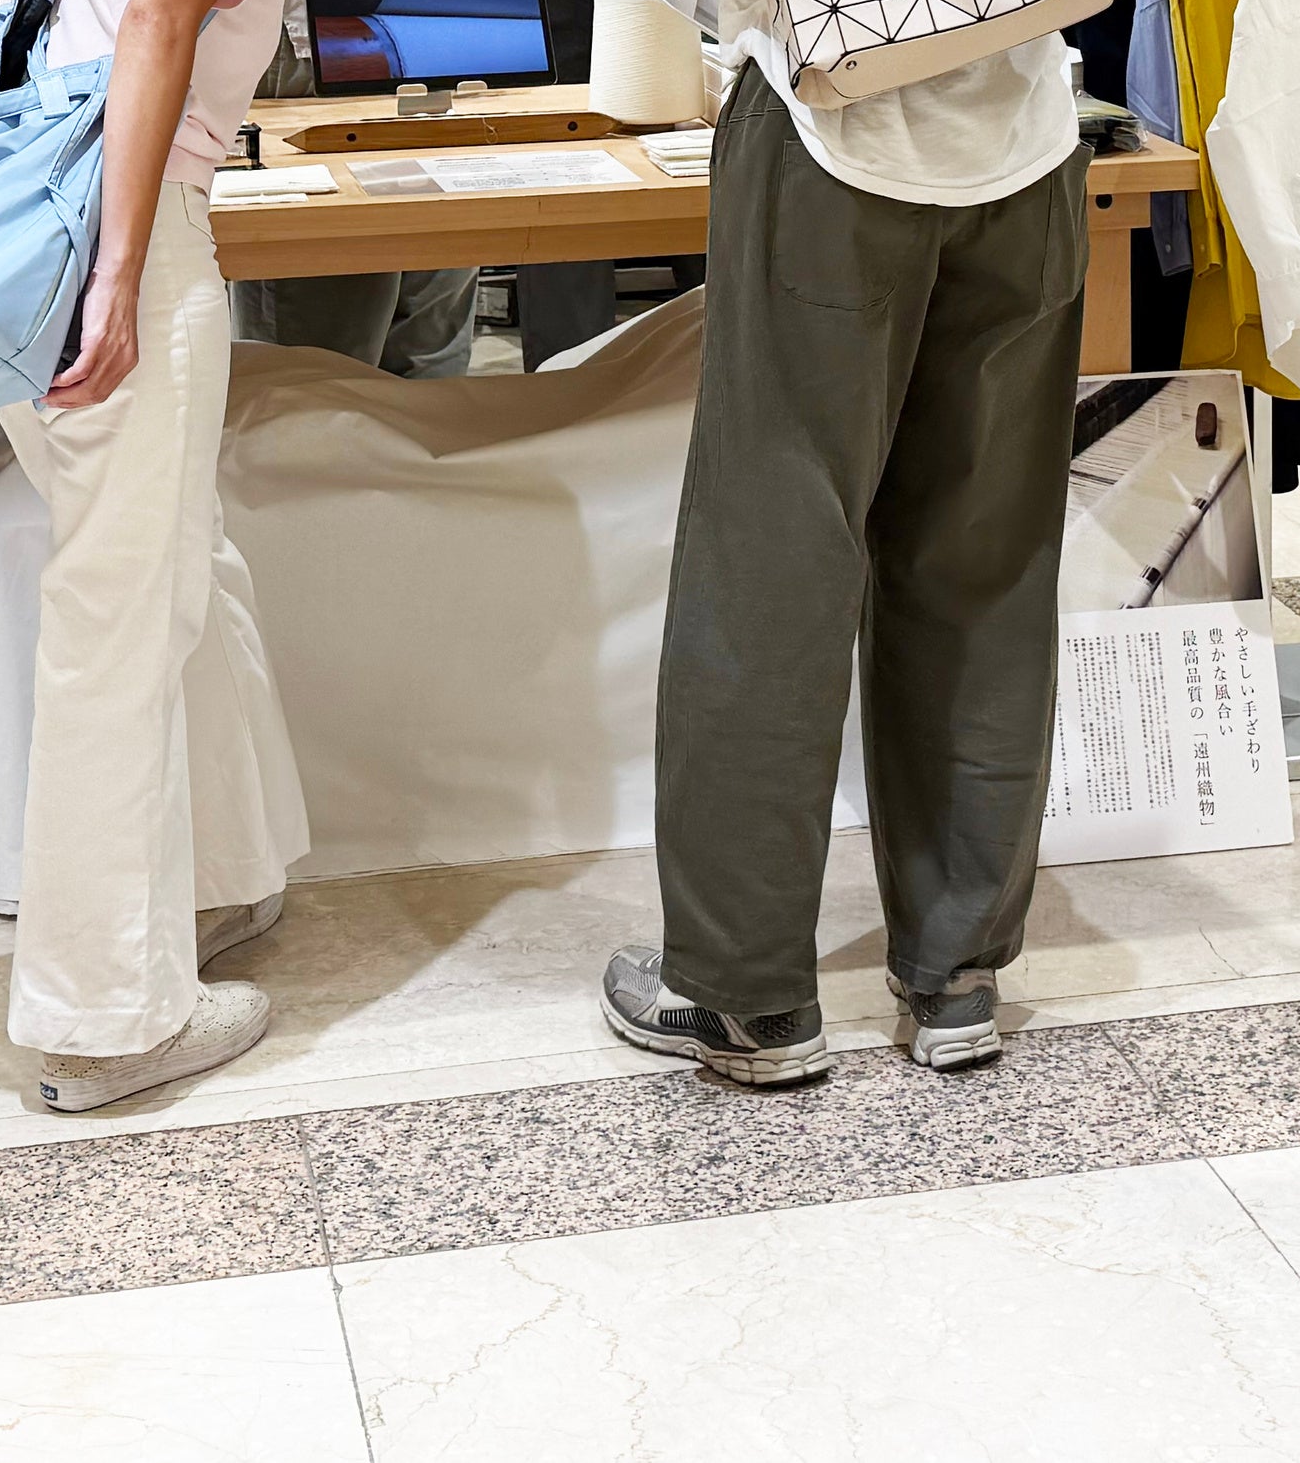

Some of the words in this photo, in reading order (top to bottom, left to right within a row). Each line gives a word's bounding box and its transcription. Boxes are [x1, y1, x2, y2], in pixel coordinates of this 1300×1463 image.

[1209, 628, 1233, 736] 豊かな風合い
[1235, 627, 1261, 773] やさしい手ざわり
